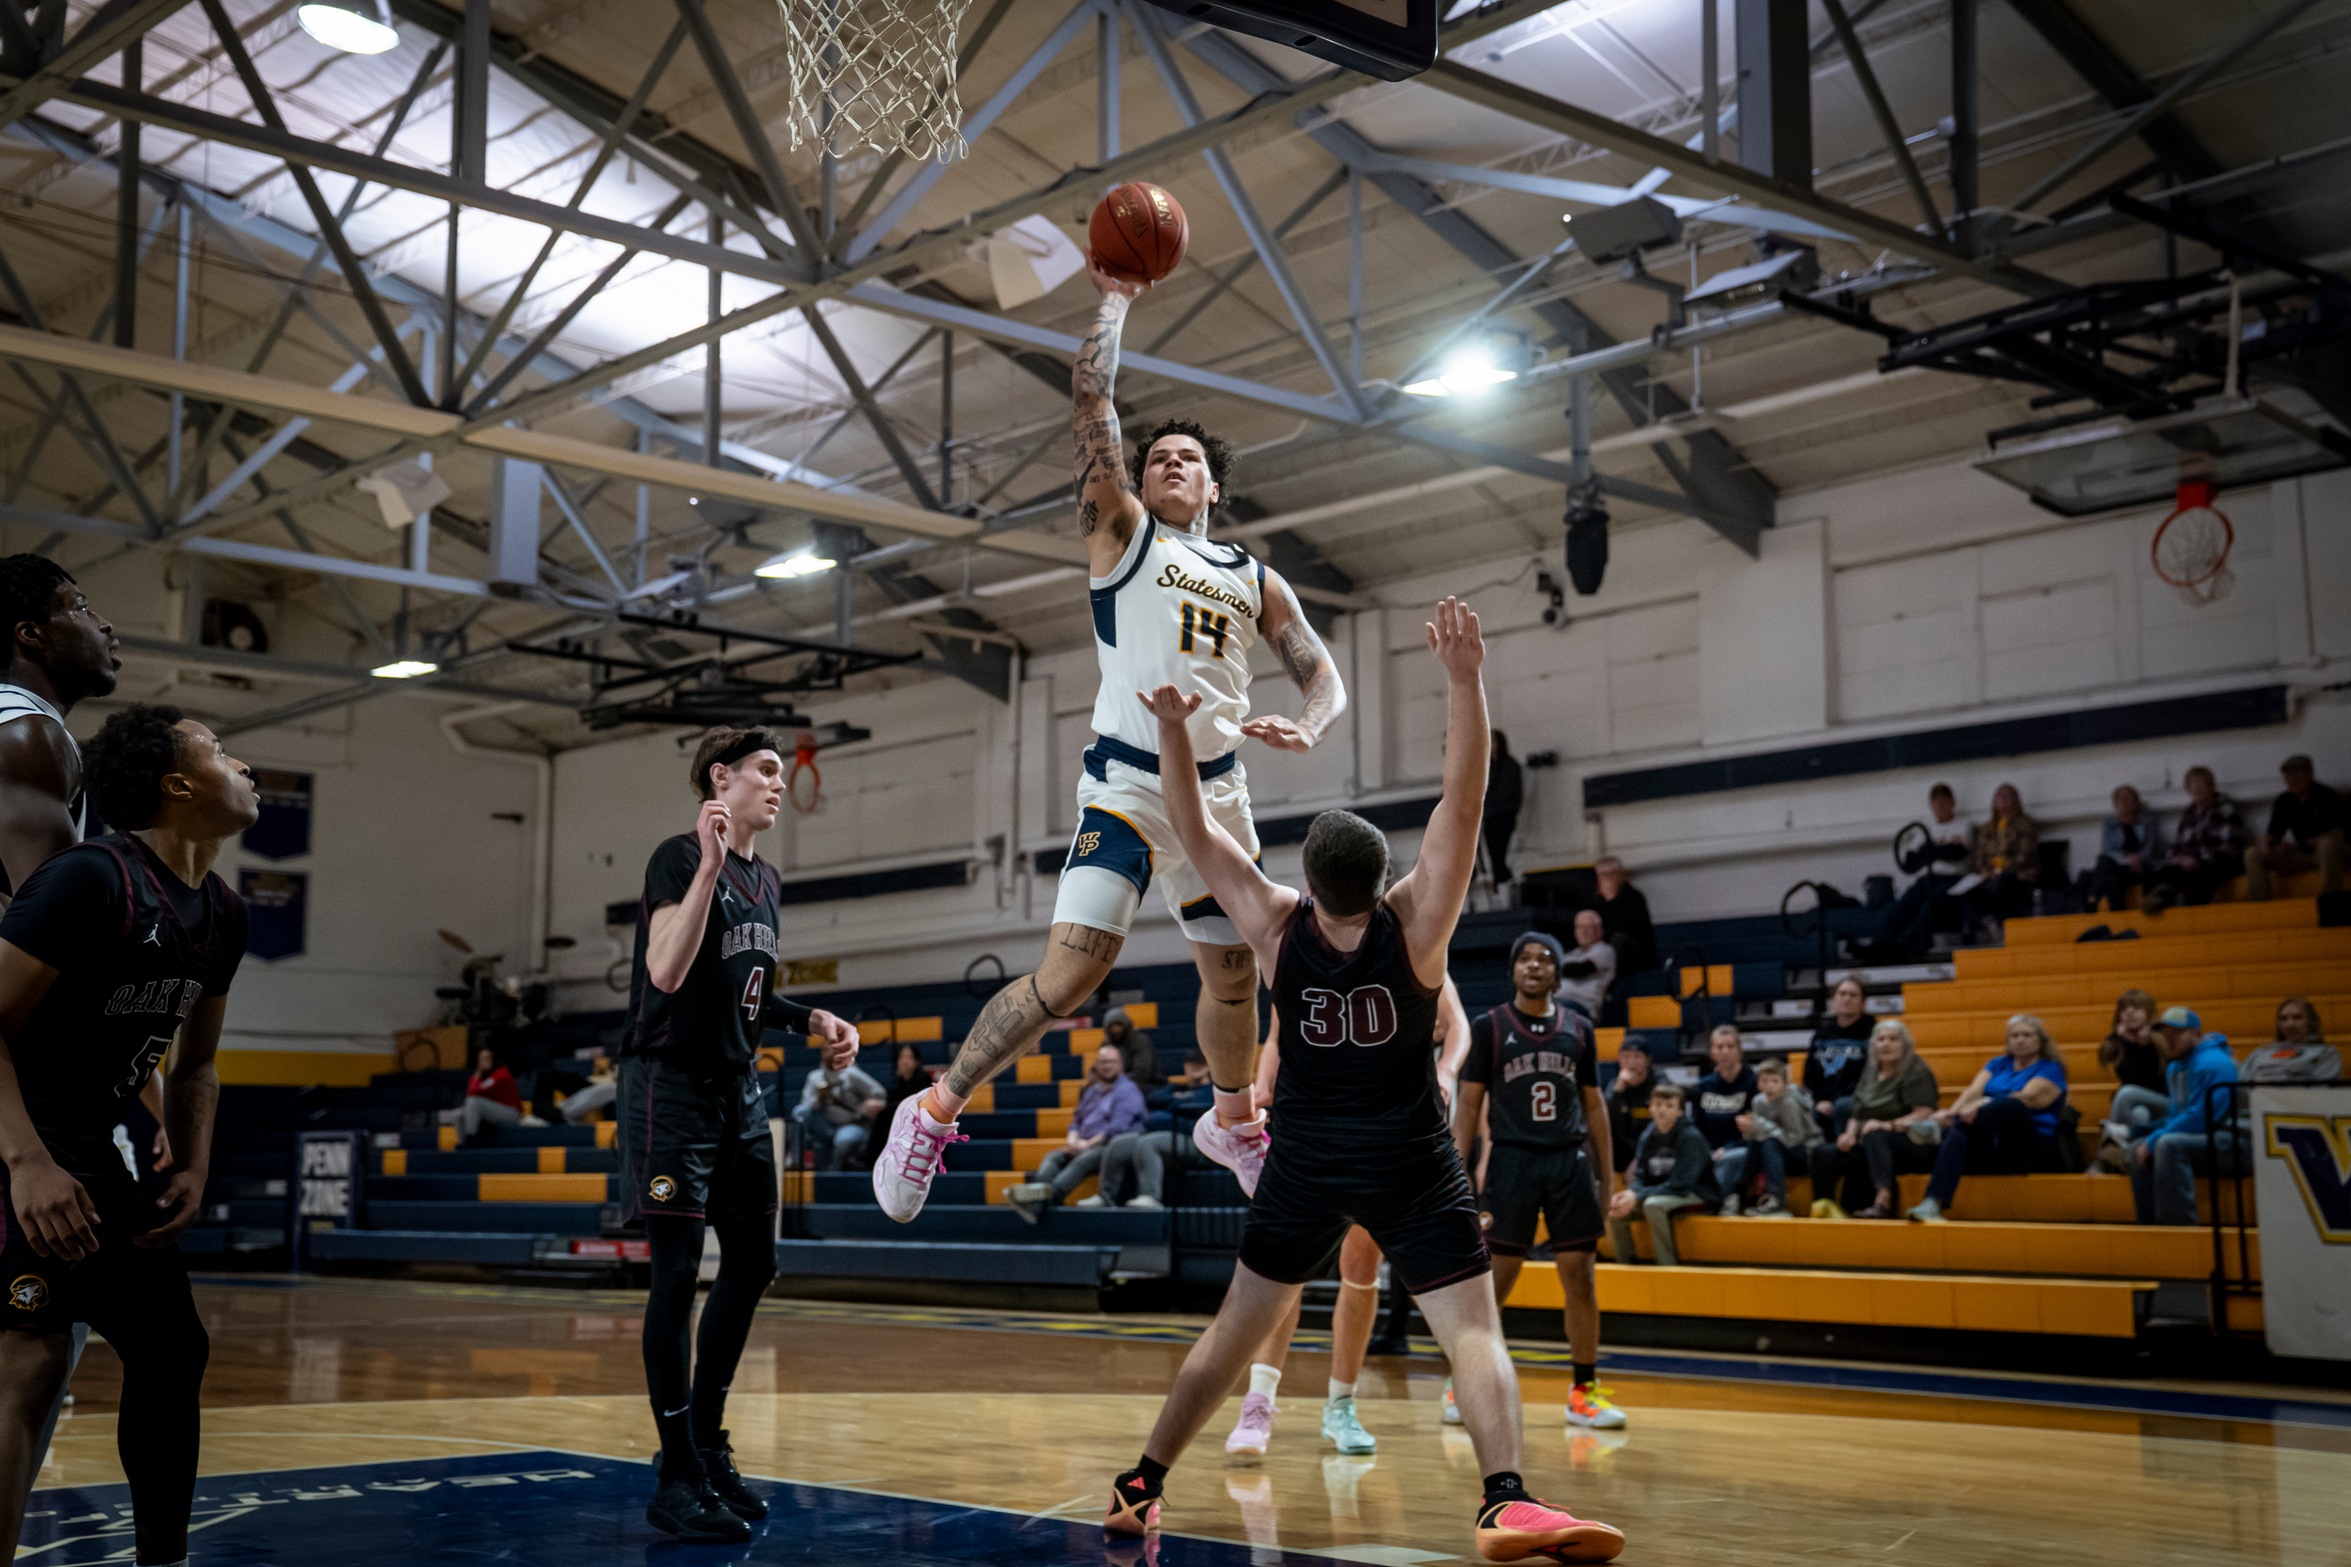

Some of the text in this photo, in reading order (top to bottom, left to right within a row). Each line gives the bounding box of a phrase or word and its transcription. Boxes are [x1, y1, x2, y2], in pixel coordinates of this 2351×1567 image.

[1179, 600, 1229, 659] 14
[721, 922, 752, 960] OAK
[104, 978, 181, 1015] OAK
[740, 966, 765, 1021] 4
[1300, 983, 1398, 1047] 30
[1503, 1052, 1536, 1083] OAK
[1531, 1081, 1557, 1121] 2
